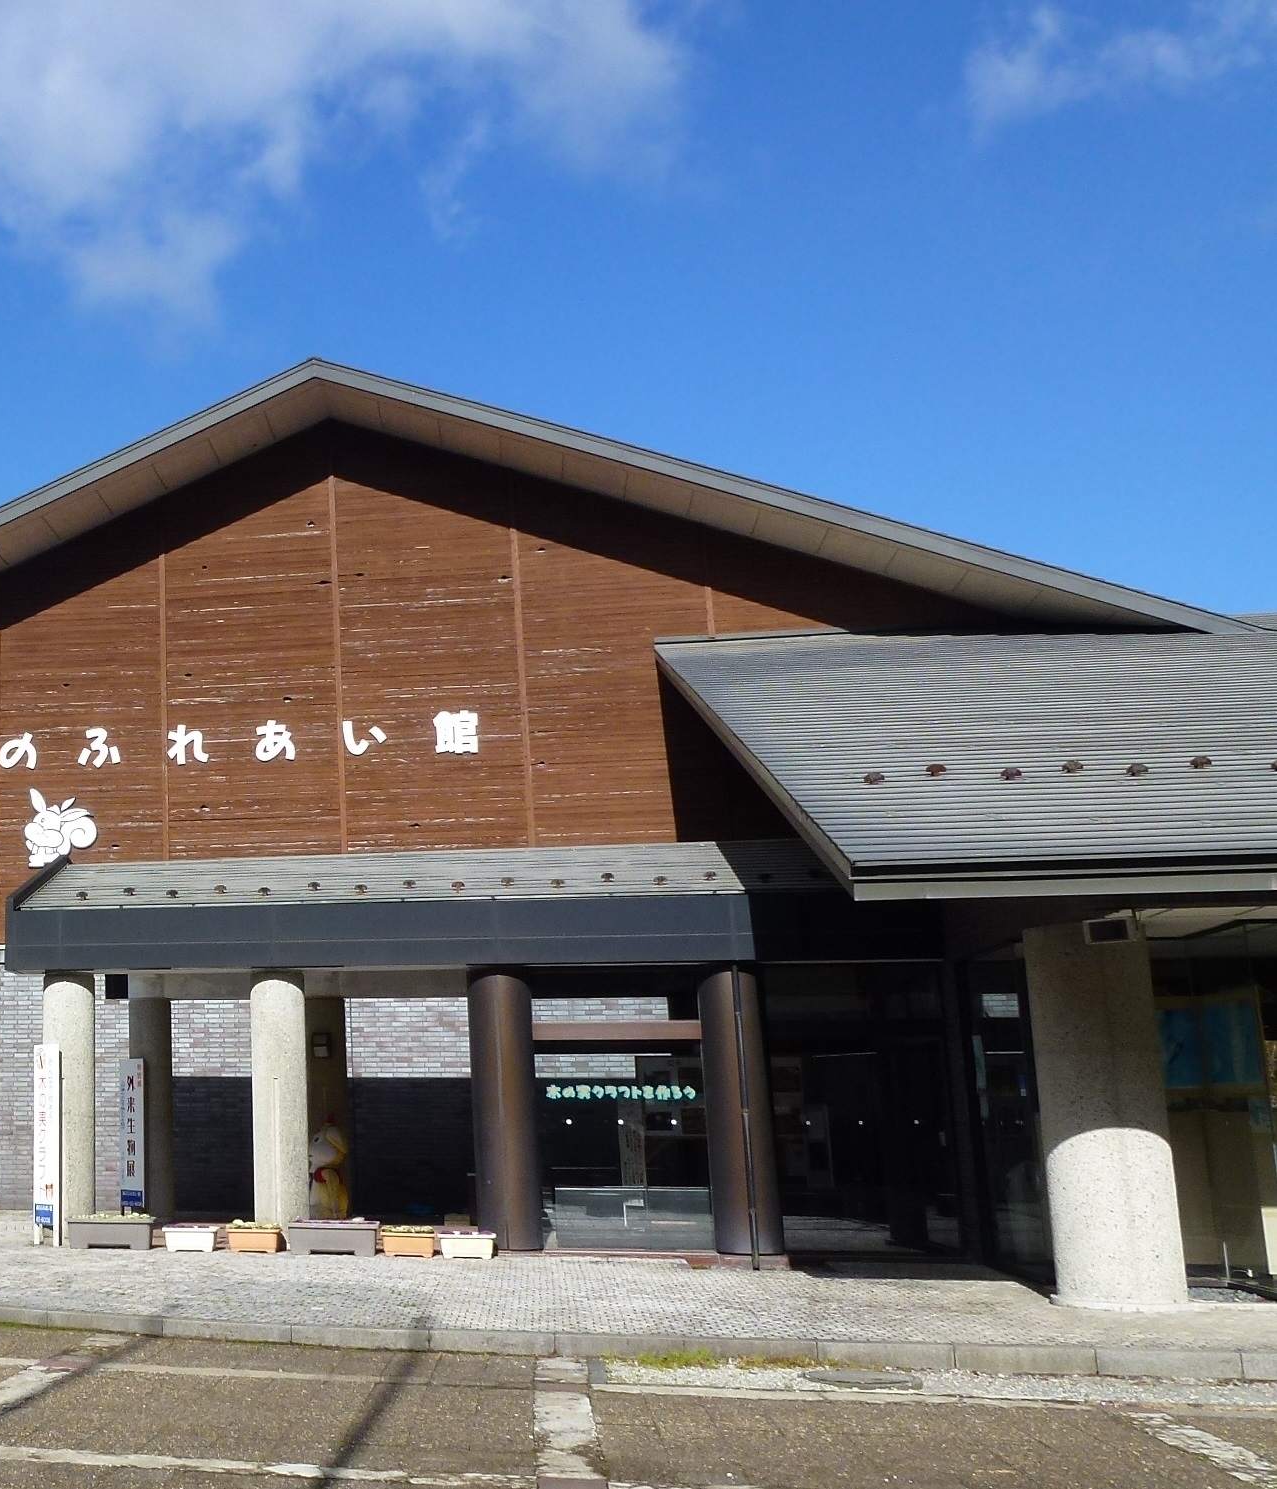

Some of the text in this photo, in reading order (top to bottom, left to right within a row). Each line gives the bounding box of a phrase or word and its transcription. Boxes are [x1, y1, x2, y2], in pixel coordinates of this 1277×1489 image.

[38, 1076, 47, 1199] 木の実クラフト
[127, 1075, 136, 1177] 外来生物展
[546, 1084, 696, 1100] 木の実クラフトを作ろう
